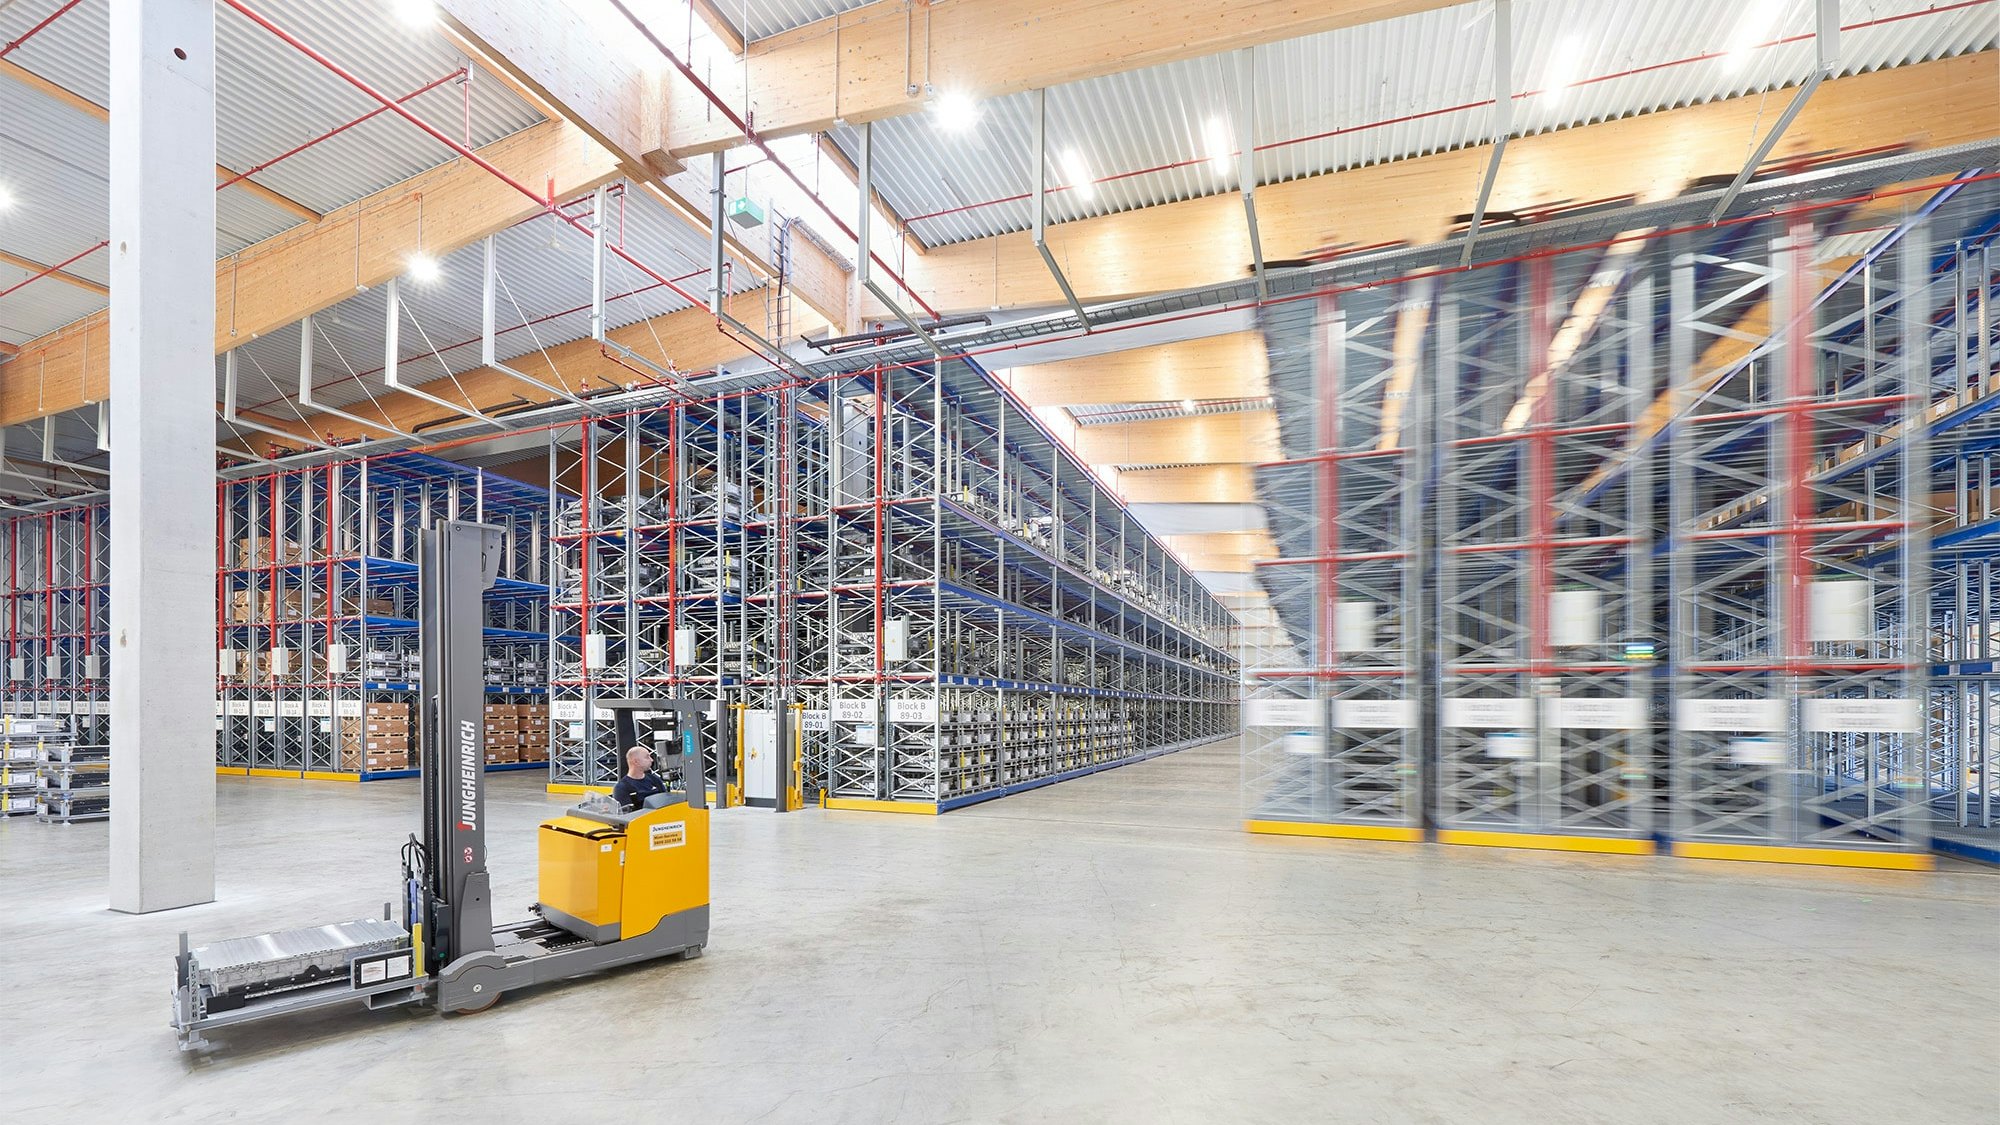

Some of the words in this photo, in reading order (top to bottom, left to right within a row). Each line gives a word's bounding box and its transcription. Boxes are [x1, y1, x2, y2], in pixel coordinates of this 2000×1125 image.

[557, 702, 571, 710] Block
[839, 701, 859, 709] Block
[861, 701, 866, 709] B
[897, 702, 919, 710] Block
[920, 702, 926, 710] B
[802, 712, 820, 720] Block
[821, 712, 827, 720] B
[842, 711, 863, 719] 89-02
[900, 712, 922, 720] 89-03
[804, 721, 824, 729] 89-01
[458, 720, 477, 831] JUNGHEINRICH
